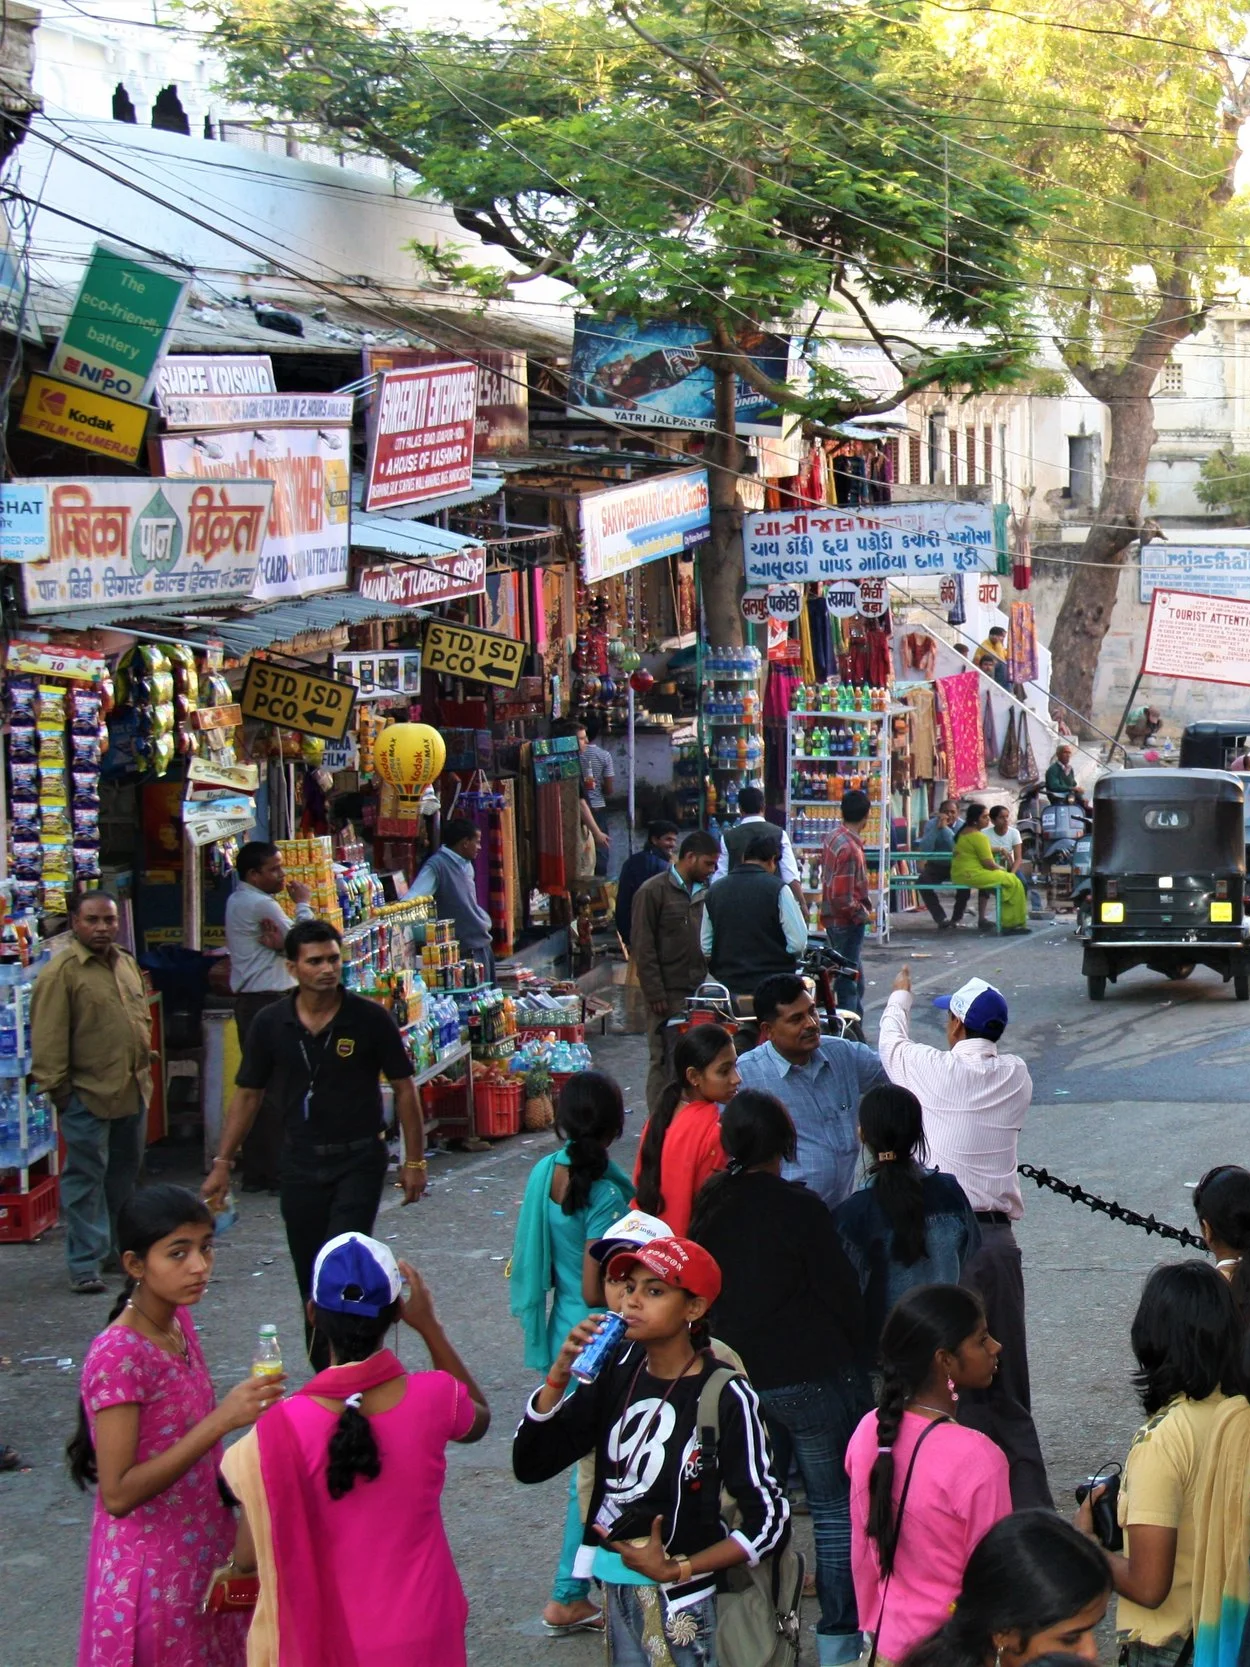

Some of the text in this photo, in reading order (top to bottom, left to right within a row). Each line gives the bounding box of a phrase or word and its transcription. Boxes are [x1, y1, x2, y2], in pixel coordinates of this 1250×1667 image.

[121, 271, 146, 294] The
[82, 292, 162, 337] eco-friendly
[87, 326, 139, 361] battery
[301, 399, 307, 417] 2
[308, 399, 327, 417] HOURS
[69, 408, 114, 432] Kodak
[614, 411, 646, 423] YATRI
[650, 414, 696, 428] JALPAN
[37, 420, 137, 456] FILM CAMERAS
[393, 453, 418, 474] HOUSE
[419, 451, 430, 470] OF
[430, 445, 462, 468] KASHMIR
[139, 518, 177, 561] पान
[186, 486, 265, 563] विक्रेता
[754, 515, 808, 537] યાત્રી
[24, 536, 45, 545] SHOP
[750, 541, 779, 557] ચાય
[452, 557, 484, 588] SHOP
[819, 558, 853, 573] પાપડ
[36, 580, 58, 600] पान
[978, 584, 999, 604] चाय
[1168, 607, 1208, 622] TOURIST
[430, 628, 518, 663] STD. ISD.
[50, 661, 64, 671] 10
[430, 648, 476, 674] PCO
[253, 668, 342, 711] STD. ISD.
[422, 738, 431, 757] MAX
[321, 752, 346, 767] FILM
[410, 751, 423, 781] Kodak
[194, 765, 233, 780] CAMEL
